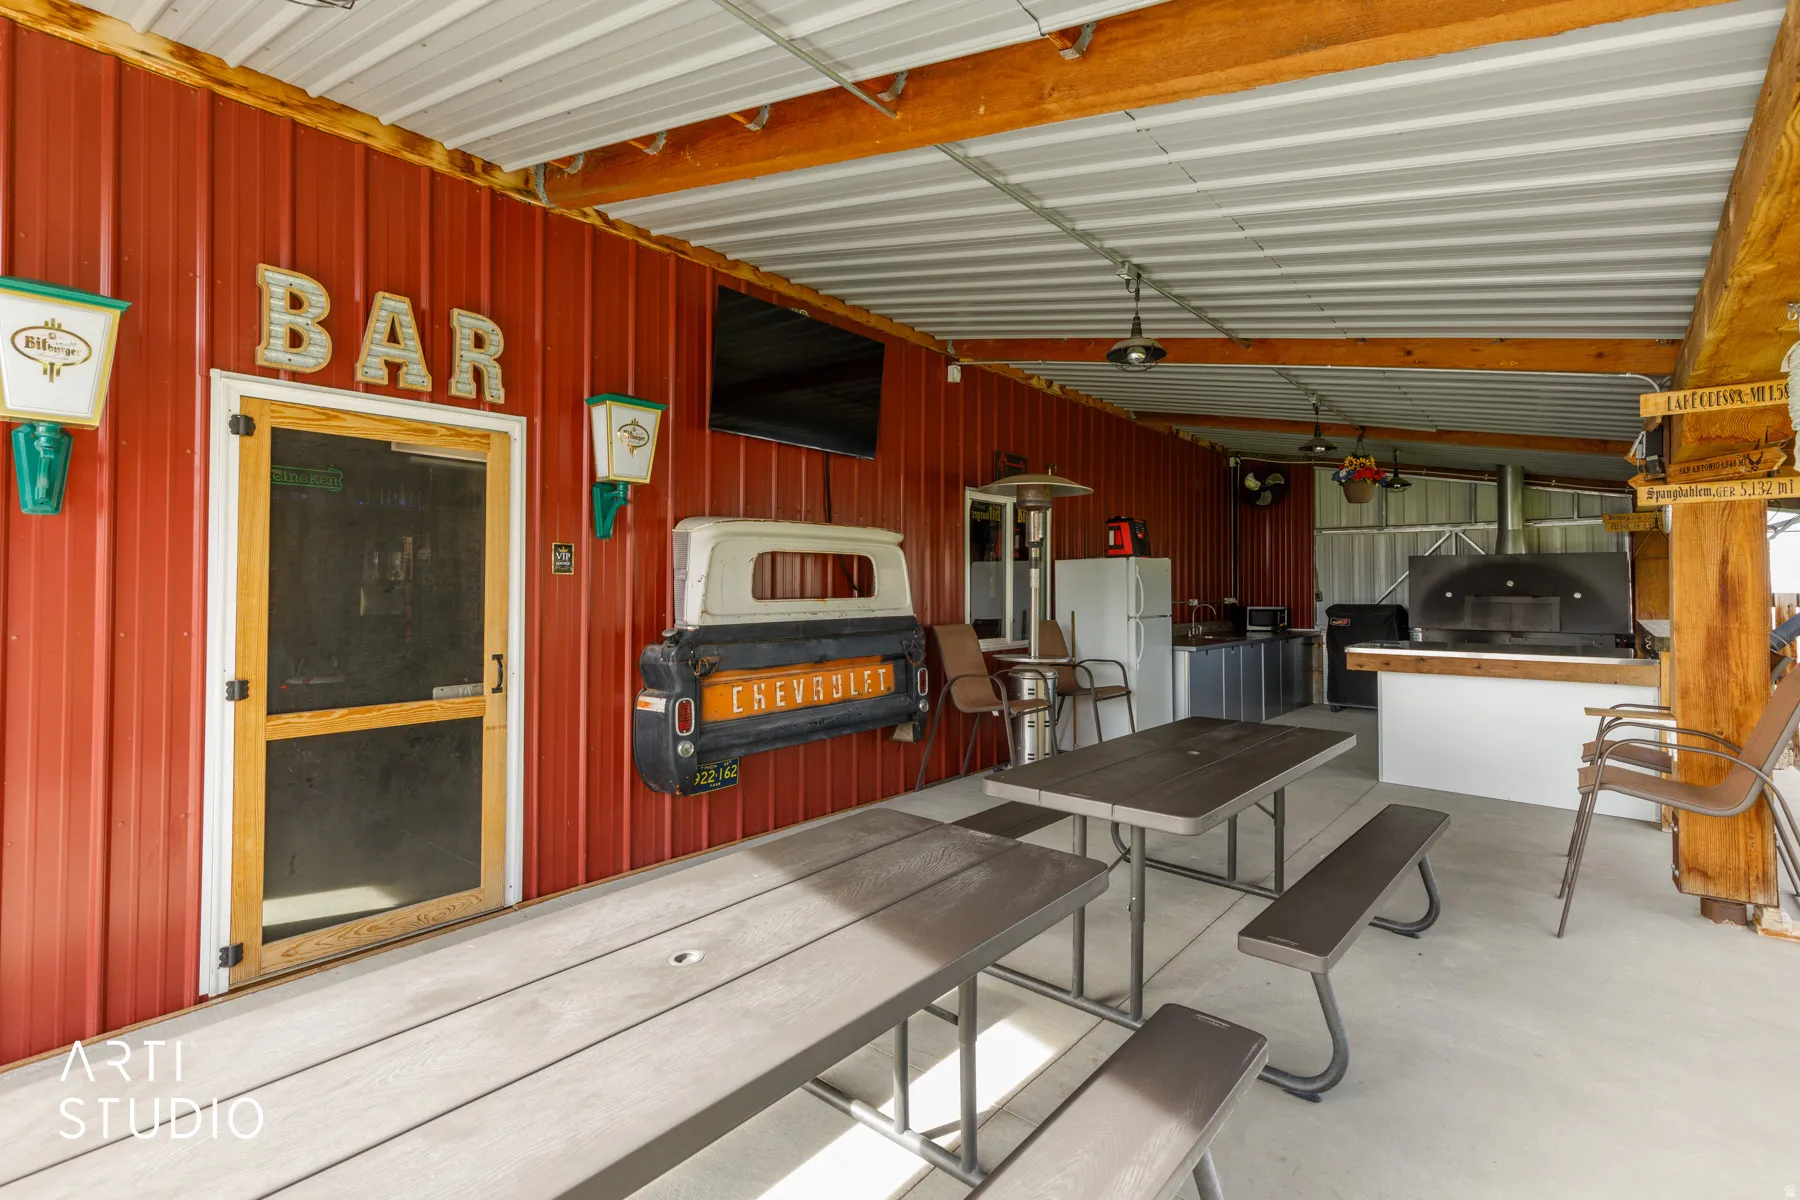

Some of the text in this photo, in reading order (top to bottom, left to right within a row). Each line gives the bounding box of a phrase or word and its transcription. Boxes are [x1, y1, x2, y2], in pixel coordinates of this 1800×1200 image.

[255, 263, 505, 404] BAR
[24, 335, 81, 356] Bitburger
[1667, 391, 1698, 411] LAKE
[1750, 385, 1766, 402] MI
[1768, 382, 1790, 402] 1,58
[271, 469, 339, 486] eineken
[1740, 480, 1773, 497] 5,132
[555, 552, 571, 560] VIP
[731, 668, 887, 714] CHEVROLET
